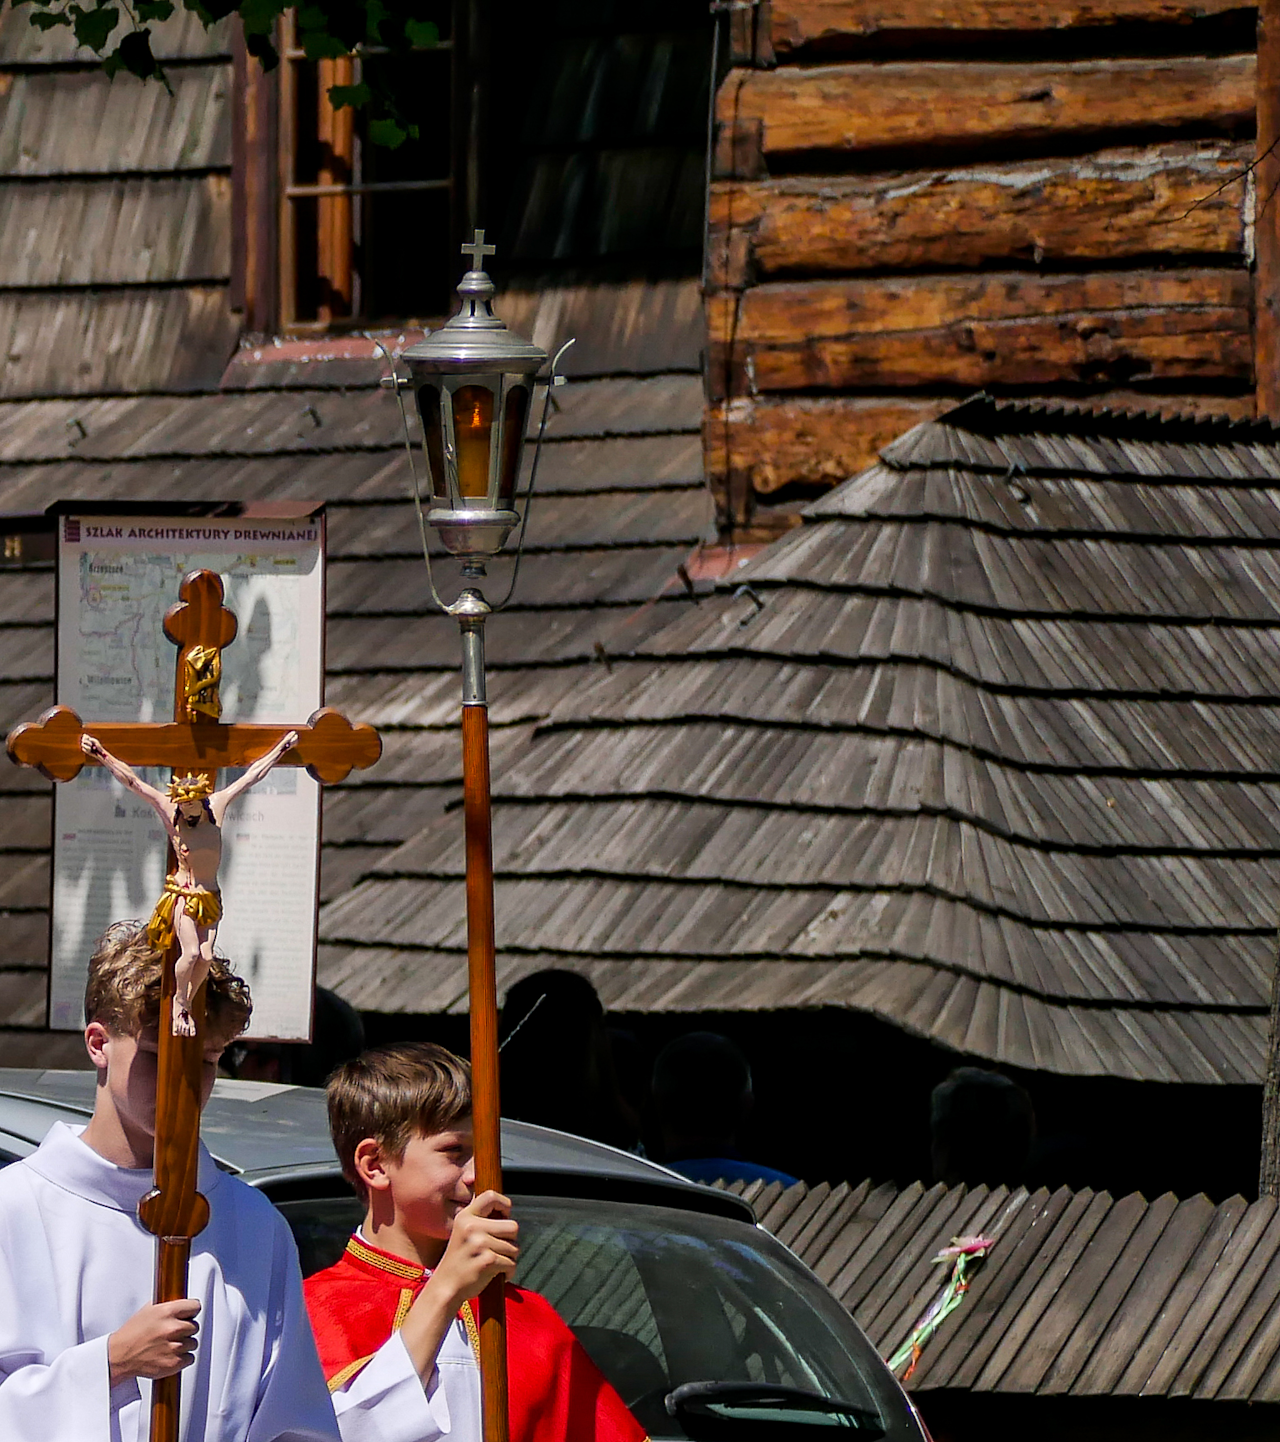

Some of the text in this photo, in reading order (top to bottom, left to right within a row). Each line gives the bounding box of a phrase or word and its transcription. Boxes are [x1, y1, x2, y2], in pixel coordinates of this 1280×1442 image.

[85, 526, 318, 541] SZLAK ARCHITEKTURY DREWNIANEJ
